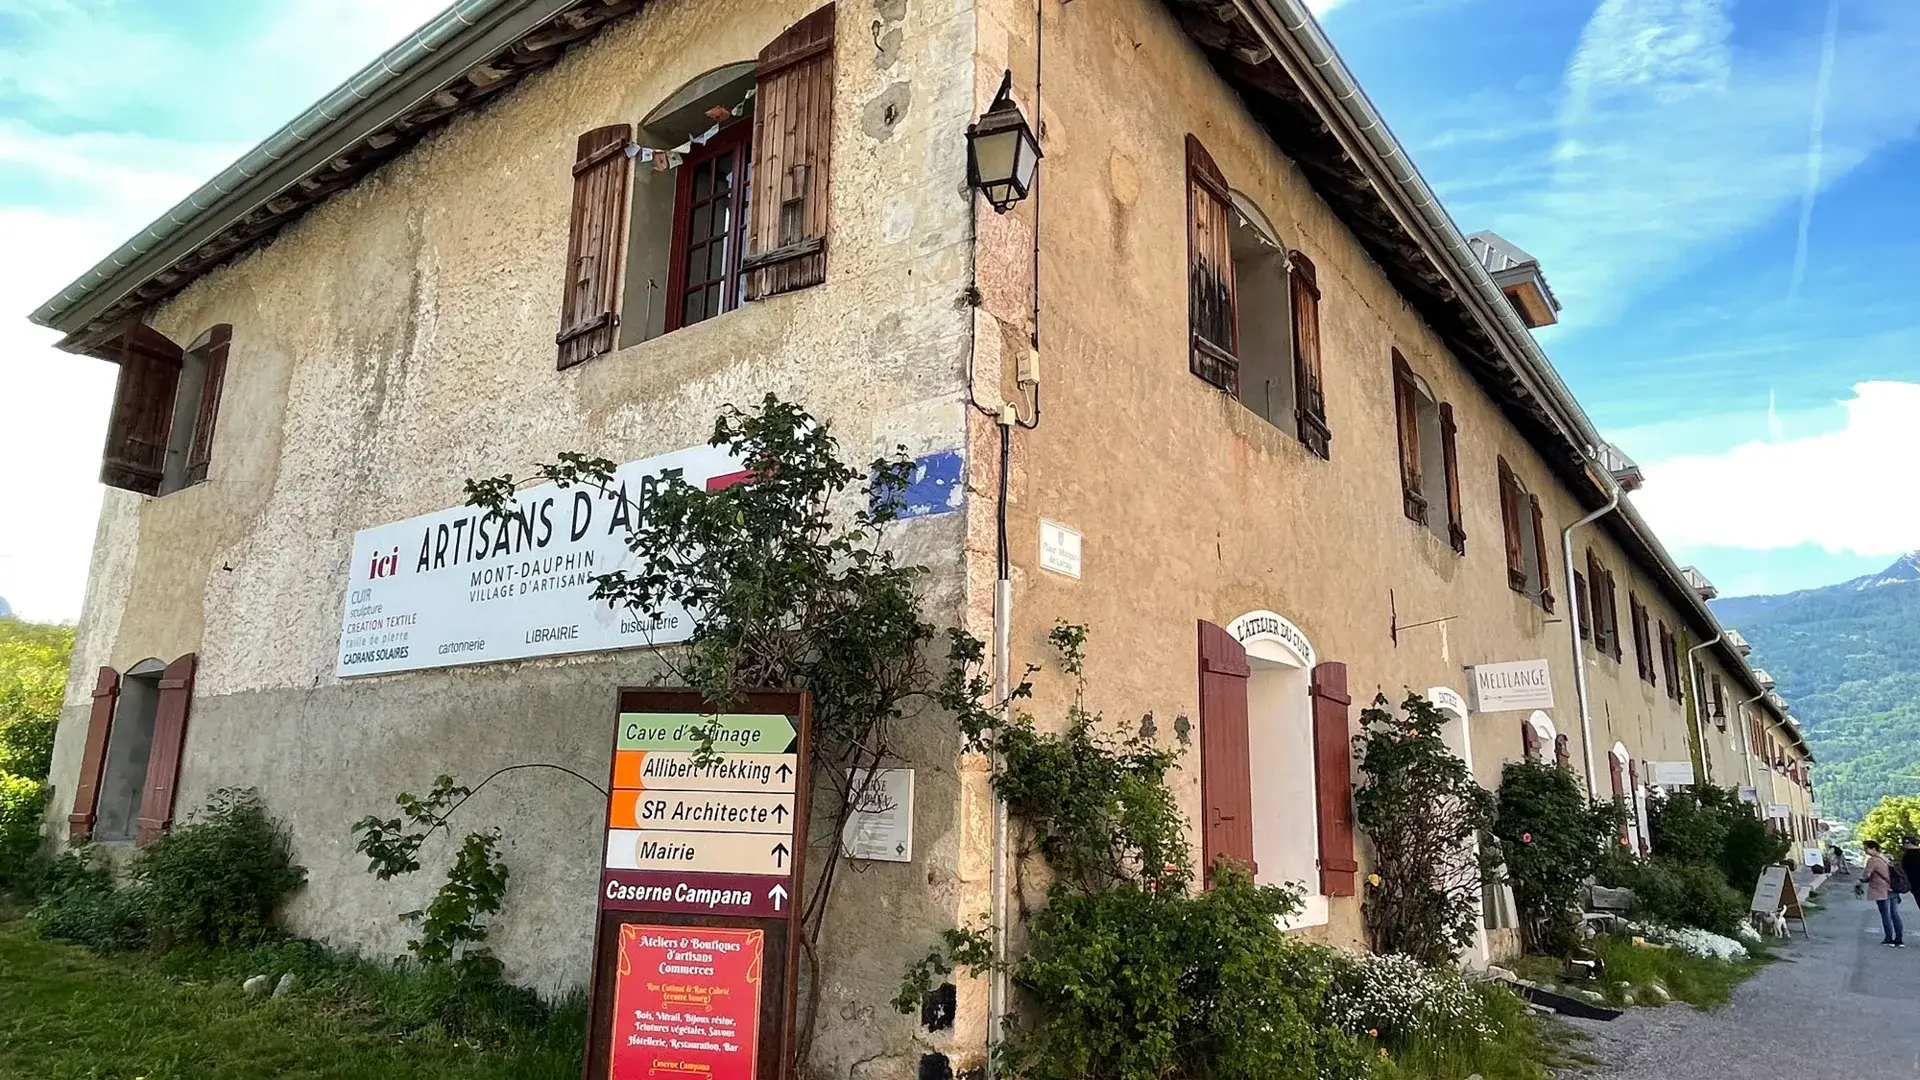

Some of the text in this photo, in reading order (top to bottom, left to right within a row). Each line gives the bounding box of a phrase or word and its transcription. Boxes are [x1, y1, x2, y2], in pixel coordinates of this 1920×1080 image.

[416, 467, 684, 573] ARTISANS D'AR
[369, 546, 398, 579] ici
[470, 550, 594, 587] MONT-DAUPHIN
[351, 588, 372, 604] CUIR
[469, 571, 593, 602] VILLAGE D'ARTISANS
[350, 604, 383, 618] sculpture
[347, 613, 417, 634] CREATION TEXTILE
[382, 631, 409, 645] pierre
[525, 625, 579, 644] LIBRAIRIE
[1237, 617, 1311, 662] L'ATELIER DU CUIR
[343, 646, 409, 665] CADRANS SOLAIRES
[438, 637, 486, 655] cartonnerie
[626, 723, 666, 741] Cave
[643, 758, 699, 778] Allibert
[642, 800, 768, 823] SR Architecte
[640, 841, 695, 861] Mairie
[606, 880, 752, 909] Caserne Campana
[639, 935, 741, 954] Ateliers & Boutiques
[666, 949, 713, 963] d'artisans
[658, 961, 714, 976] Commerces
[634, 1010, 737, 1027] Bois, Vitrail, Bijoux résine,
[634, 1022, 669, 1033] Teintures
[708, 1027, 735, 1038] Savons
[669, 1038, 722, 1052] Restauration,
[722, 1042, 739, 1052] Bar
